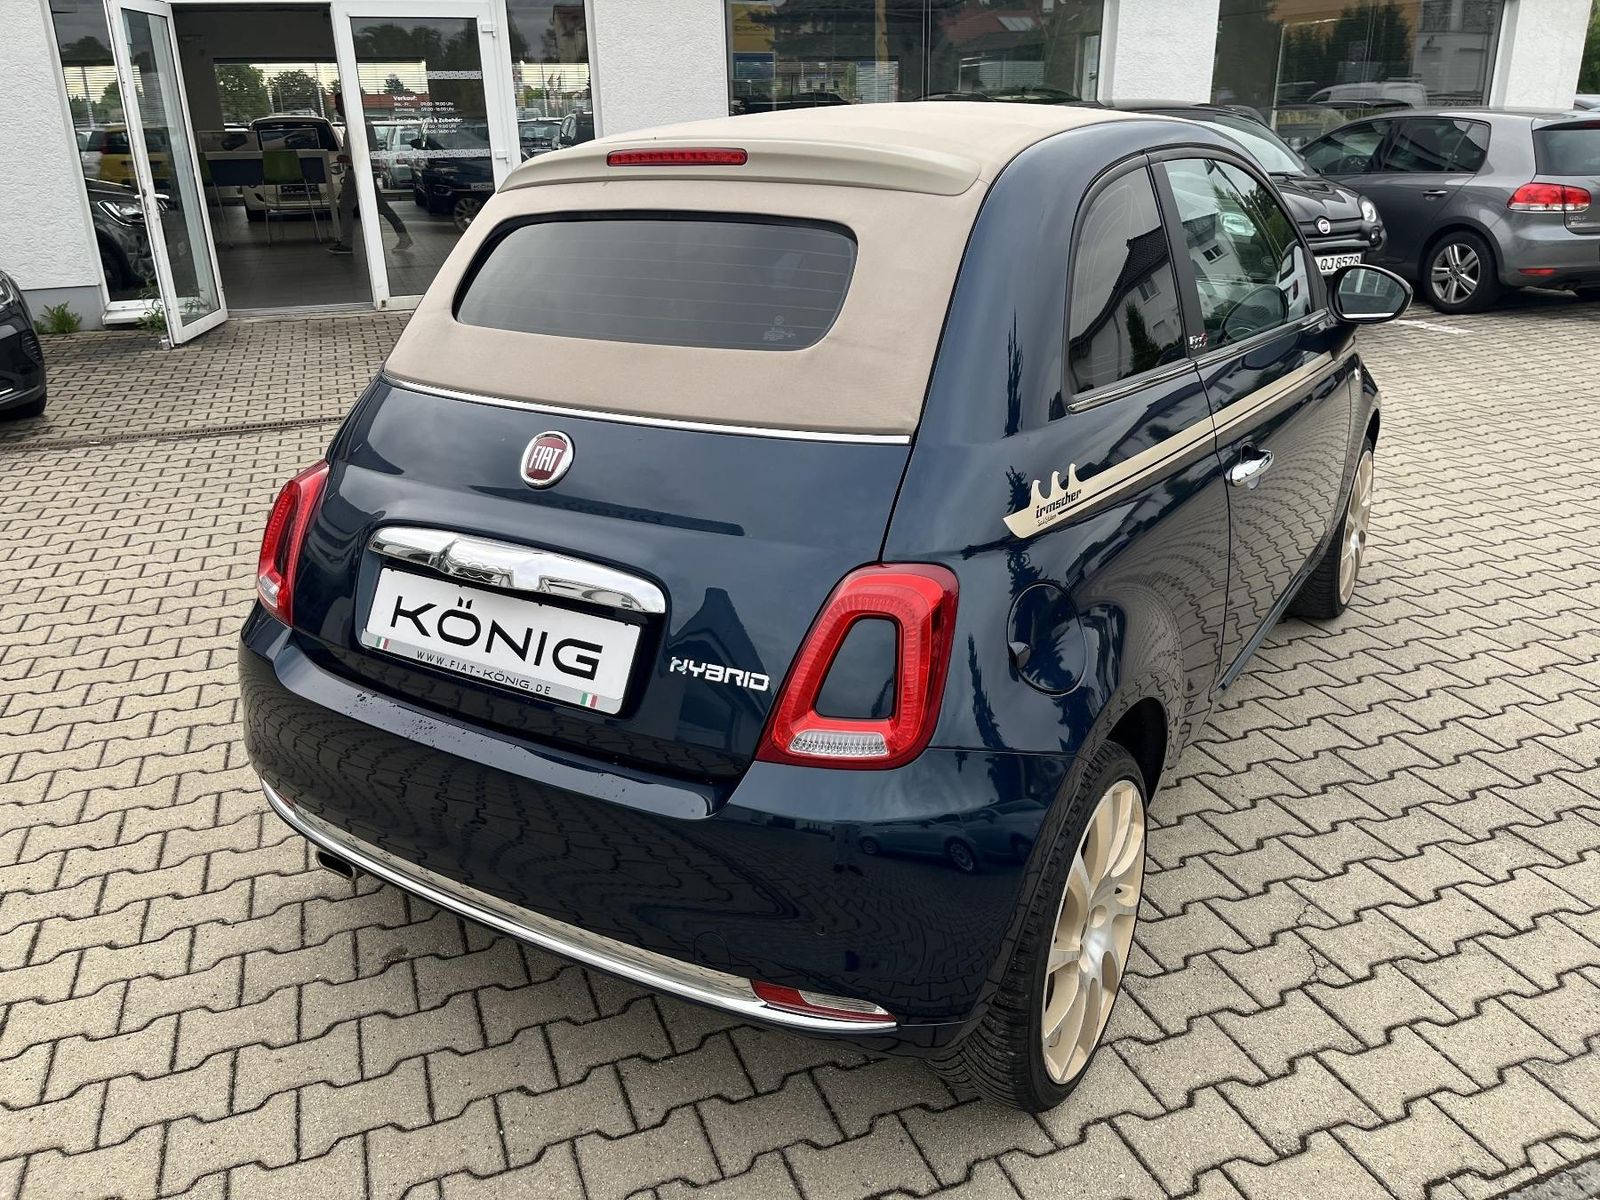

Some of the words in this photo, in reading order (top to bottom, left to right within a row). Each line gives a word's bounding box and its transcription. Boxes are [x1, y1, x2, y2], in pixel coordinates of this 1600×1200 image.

[529, 445, 563, 472] FIAT
[1035, 489, 1082, 519] irmscher
[390, 595, 604, 681] KÖNIG
[416, 650, 551, 695] WWW.FIAT-KÖNIG.DE
[669, 656, 770, 692] HYBRID
